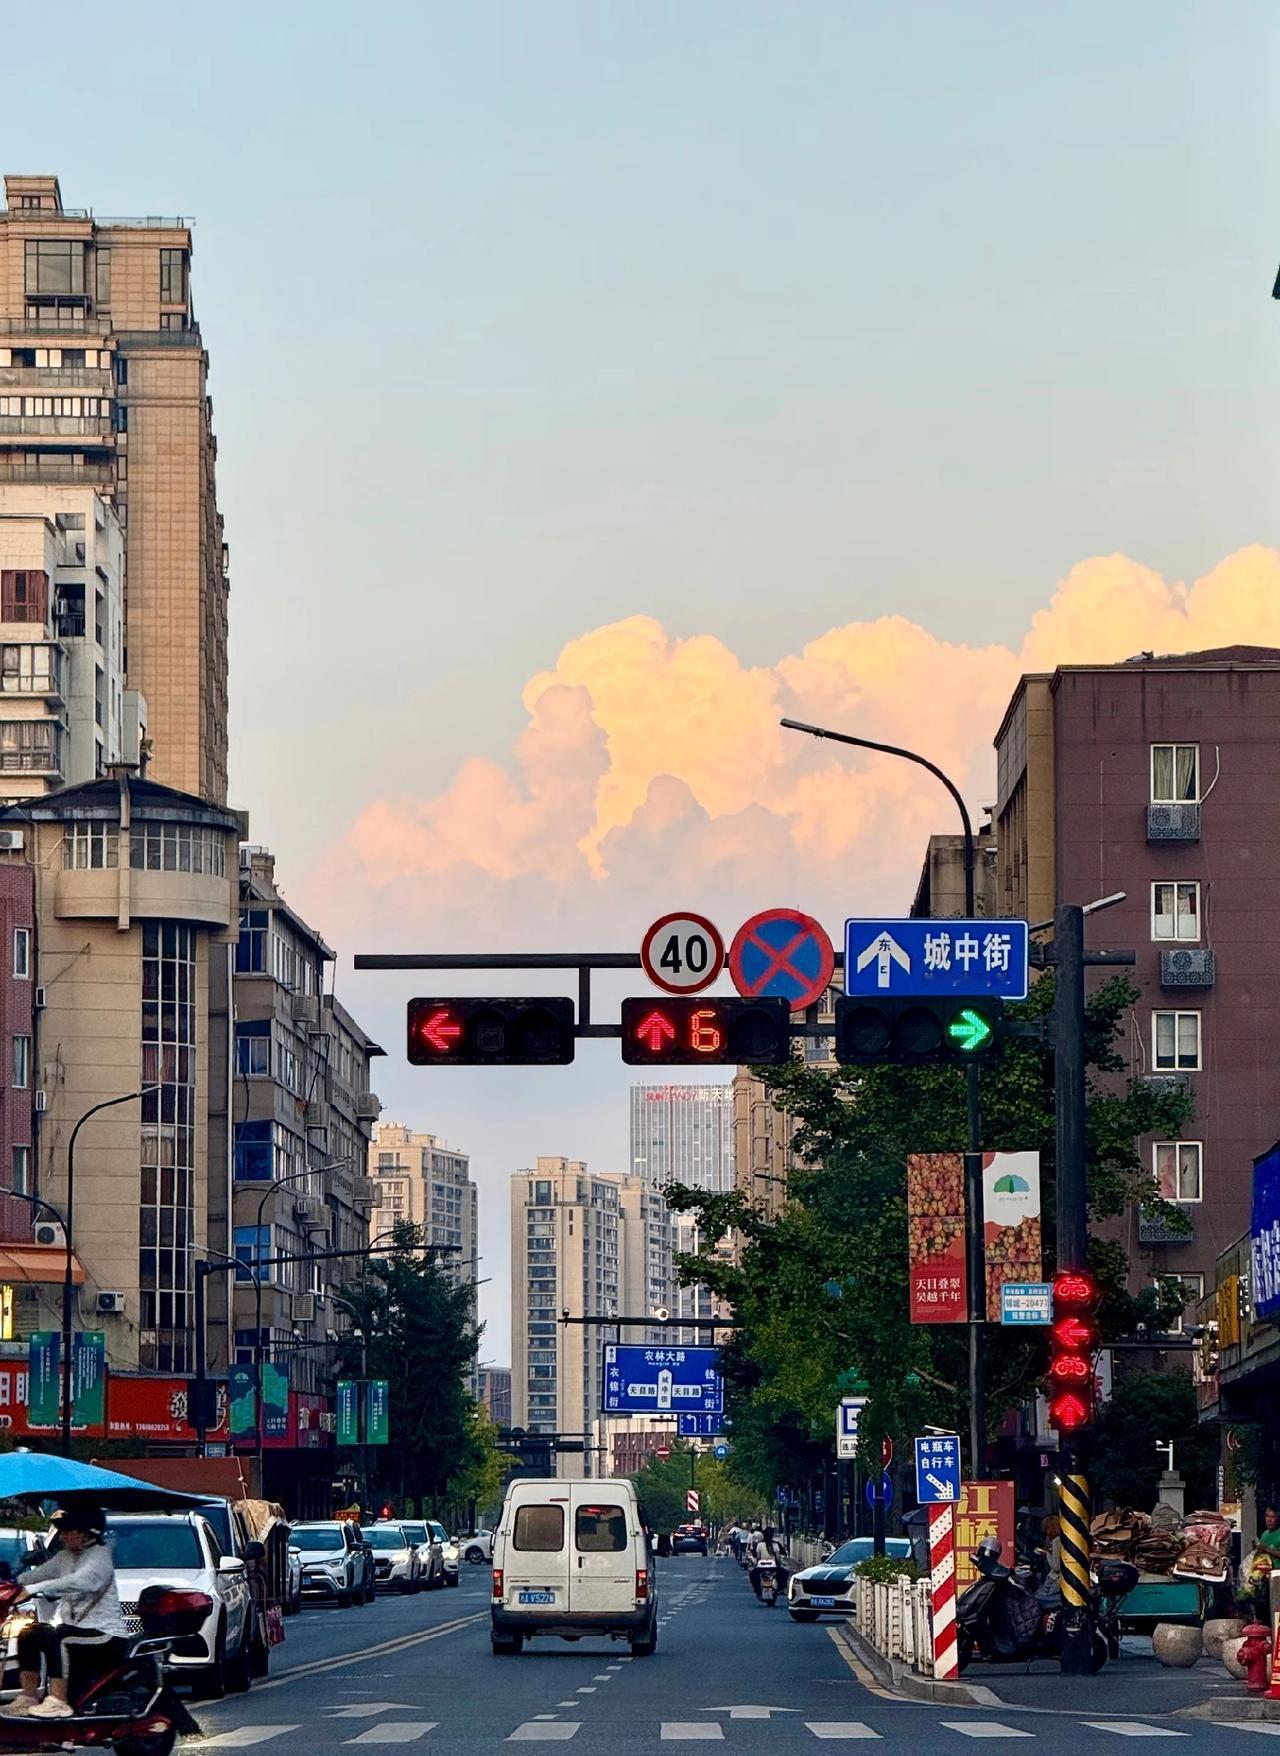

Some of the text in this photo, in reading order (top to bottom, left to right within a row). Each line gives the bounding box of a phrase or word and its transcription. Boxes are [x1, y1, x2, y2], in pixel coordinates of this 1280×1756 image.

[879, 939, 891, 952] 东
[660, 935, 708, 974] 40
[924, 933, 1011, 972] 城中街
[881, 966, 887, 974] E
[690, 1010, 720, 1051] 6
[916, 1278, 961, 1290] 天目叠翠
[916, 1291, 961, 1303] 吴越千年
[645, 1351, 686, 1362] 农林大路
[920, 1440, 955, 1453] 电瓶车
[921, 1456, 955, 1470] 自行车
